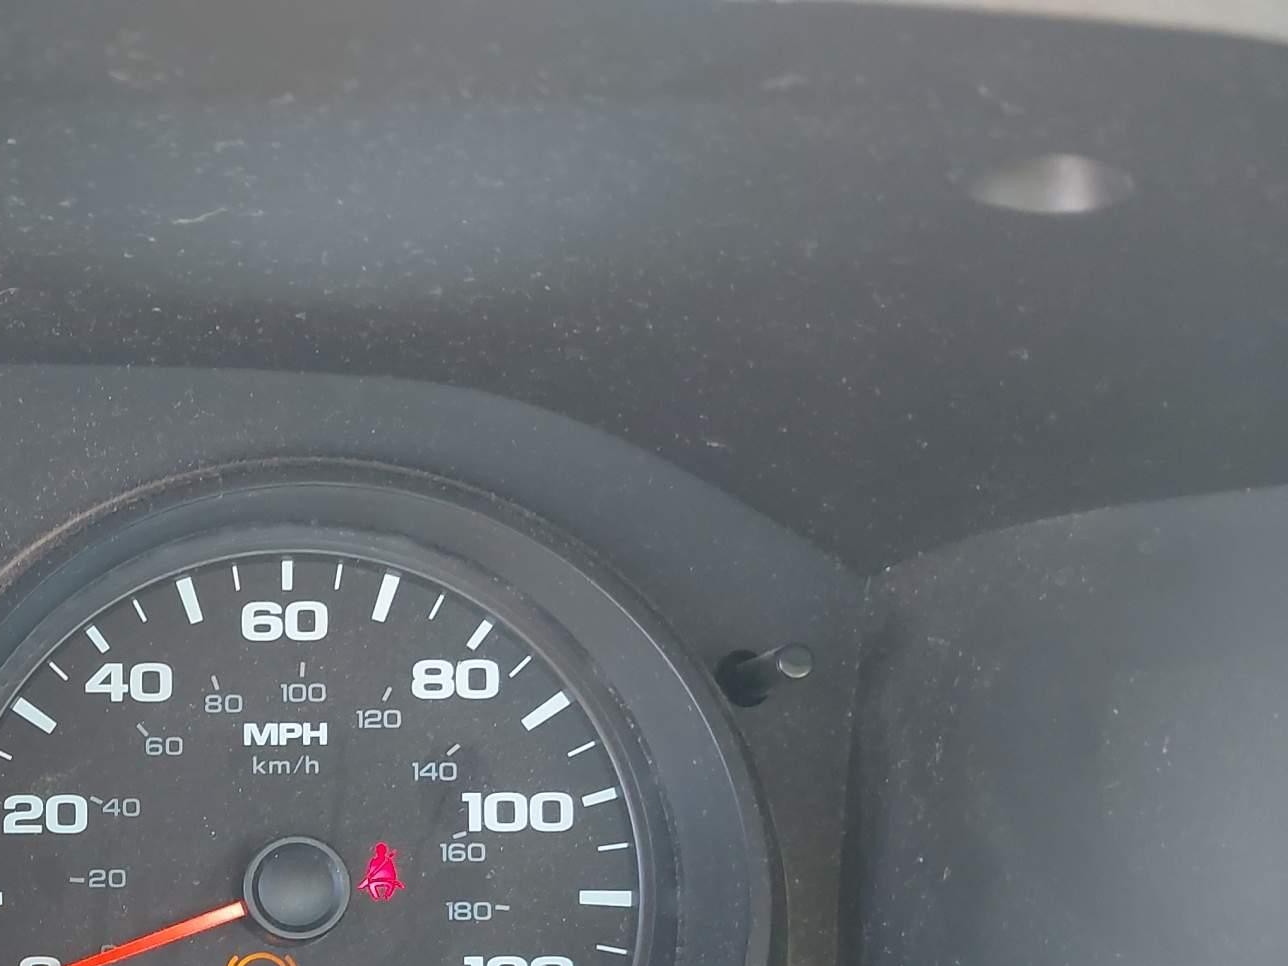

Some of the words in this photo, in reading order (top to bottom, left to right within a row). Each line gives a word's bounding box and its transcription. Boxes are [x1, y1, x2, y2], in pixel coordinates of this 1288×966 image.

[241, 601, 328, 641] 60
[85, 663, 173, 702] 40
[411, 659, 499, 699] 80
[280, 683, 327, 702] 100
[204, 694, 243, 713] 80
[356, 709, 402, 729] 120
[243, 722, 328, 746] MPH
[145, 737, 183, 756] 60
[252, 755, 320, 775] km/h
[412, 762, 458, 781] 140
[3, 794, 88, 833] 20
[102, 798, 141, 817] 40
[461, 792, 574, 832] 100
[439, 843, 486, 862] 160
[88, 869, 127, 888] 20
[446, 902, 492, 921] 180
